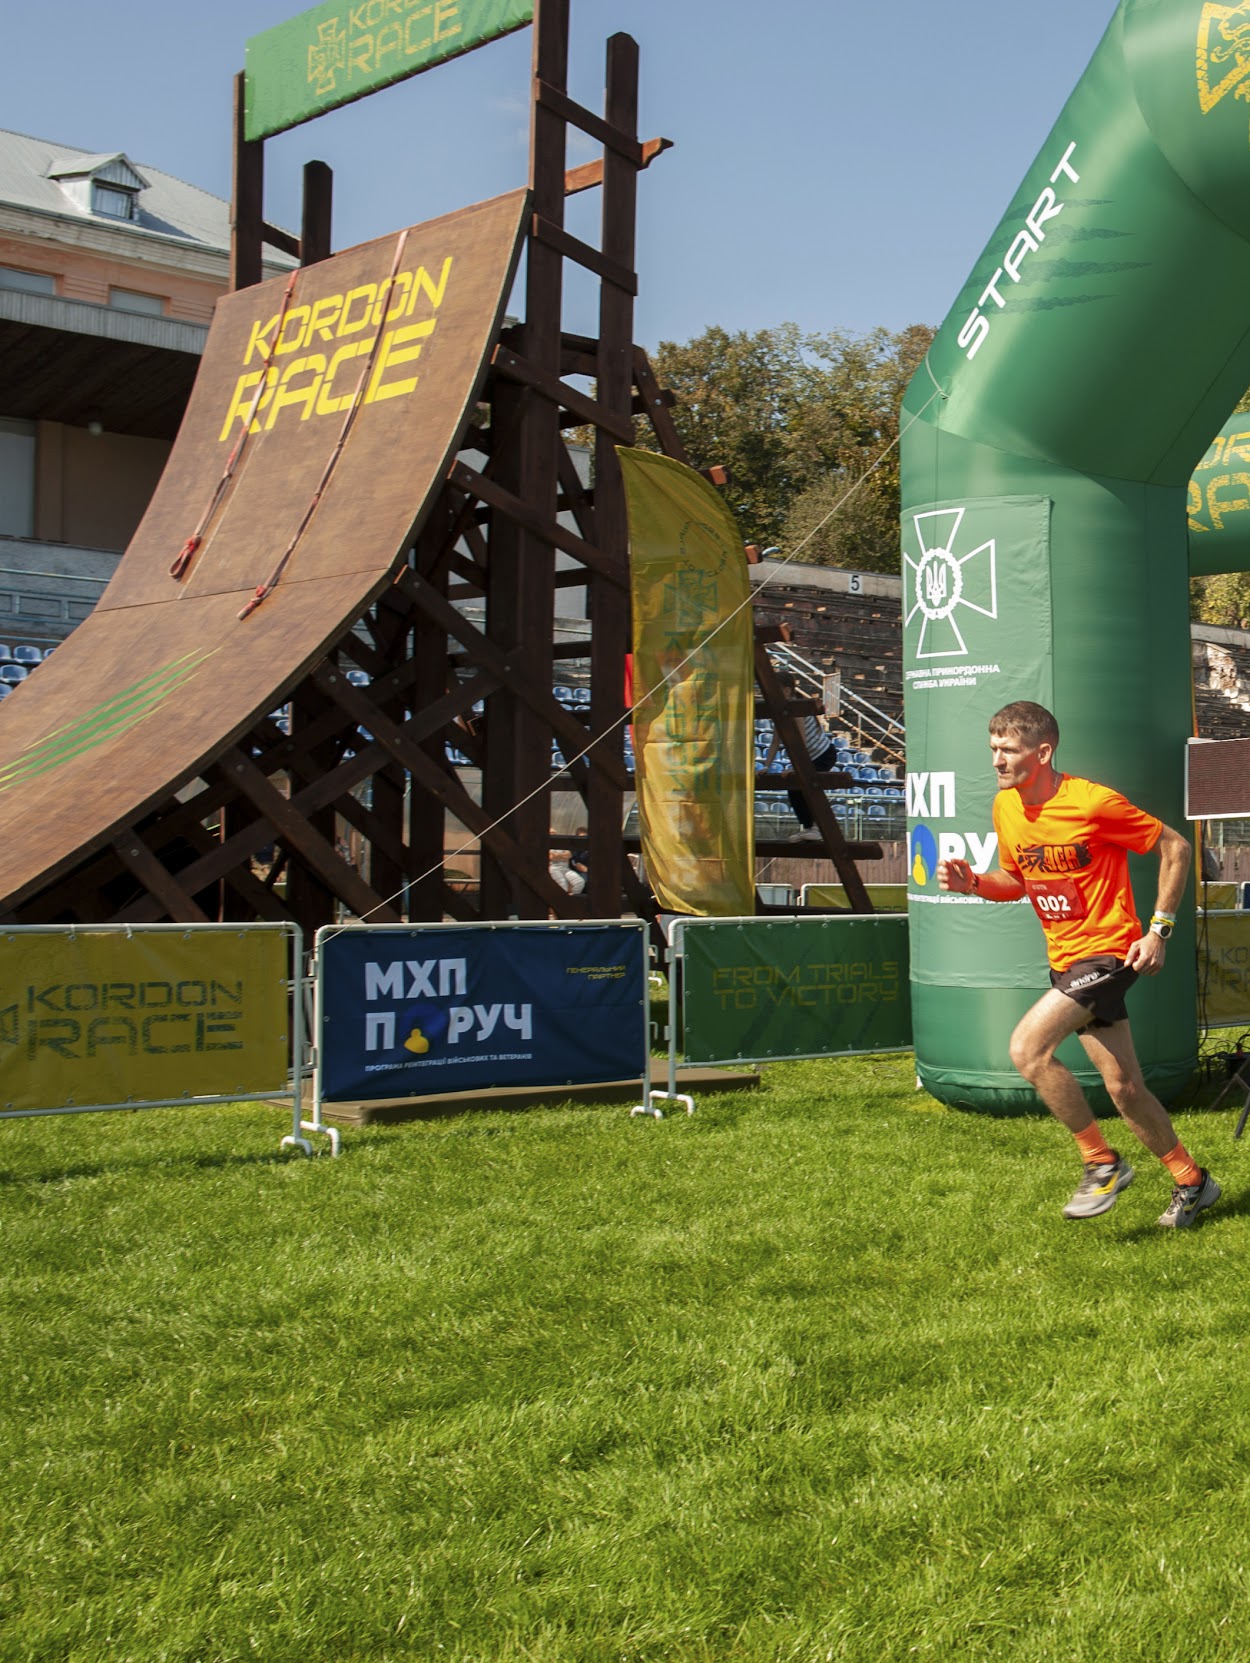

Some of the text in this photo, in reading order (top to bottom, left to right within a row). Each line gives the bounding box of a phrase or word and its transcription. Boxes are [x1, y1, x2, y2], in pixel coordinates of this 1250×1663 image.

[349, 0, 418, 35] KOR
[347, 0, 462, 81] RACE
[957, 141, 1081, 360] START
[243, 256, 453, 366] KORDON
[219, 318, 437, 442] RACE
[851, 574, 860, 592] 5
[1036, 895, 1071, 912] 002
[365, 957, 467, 1001] МХП
[712, 961, 898, 987] FROM TRIALS
[27, 979, 243, 1013] KORDON
[712, 980, 898, 1010] TO VICTORY
[27, 1011, 244, 1061] RACE
